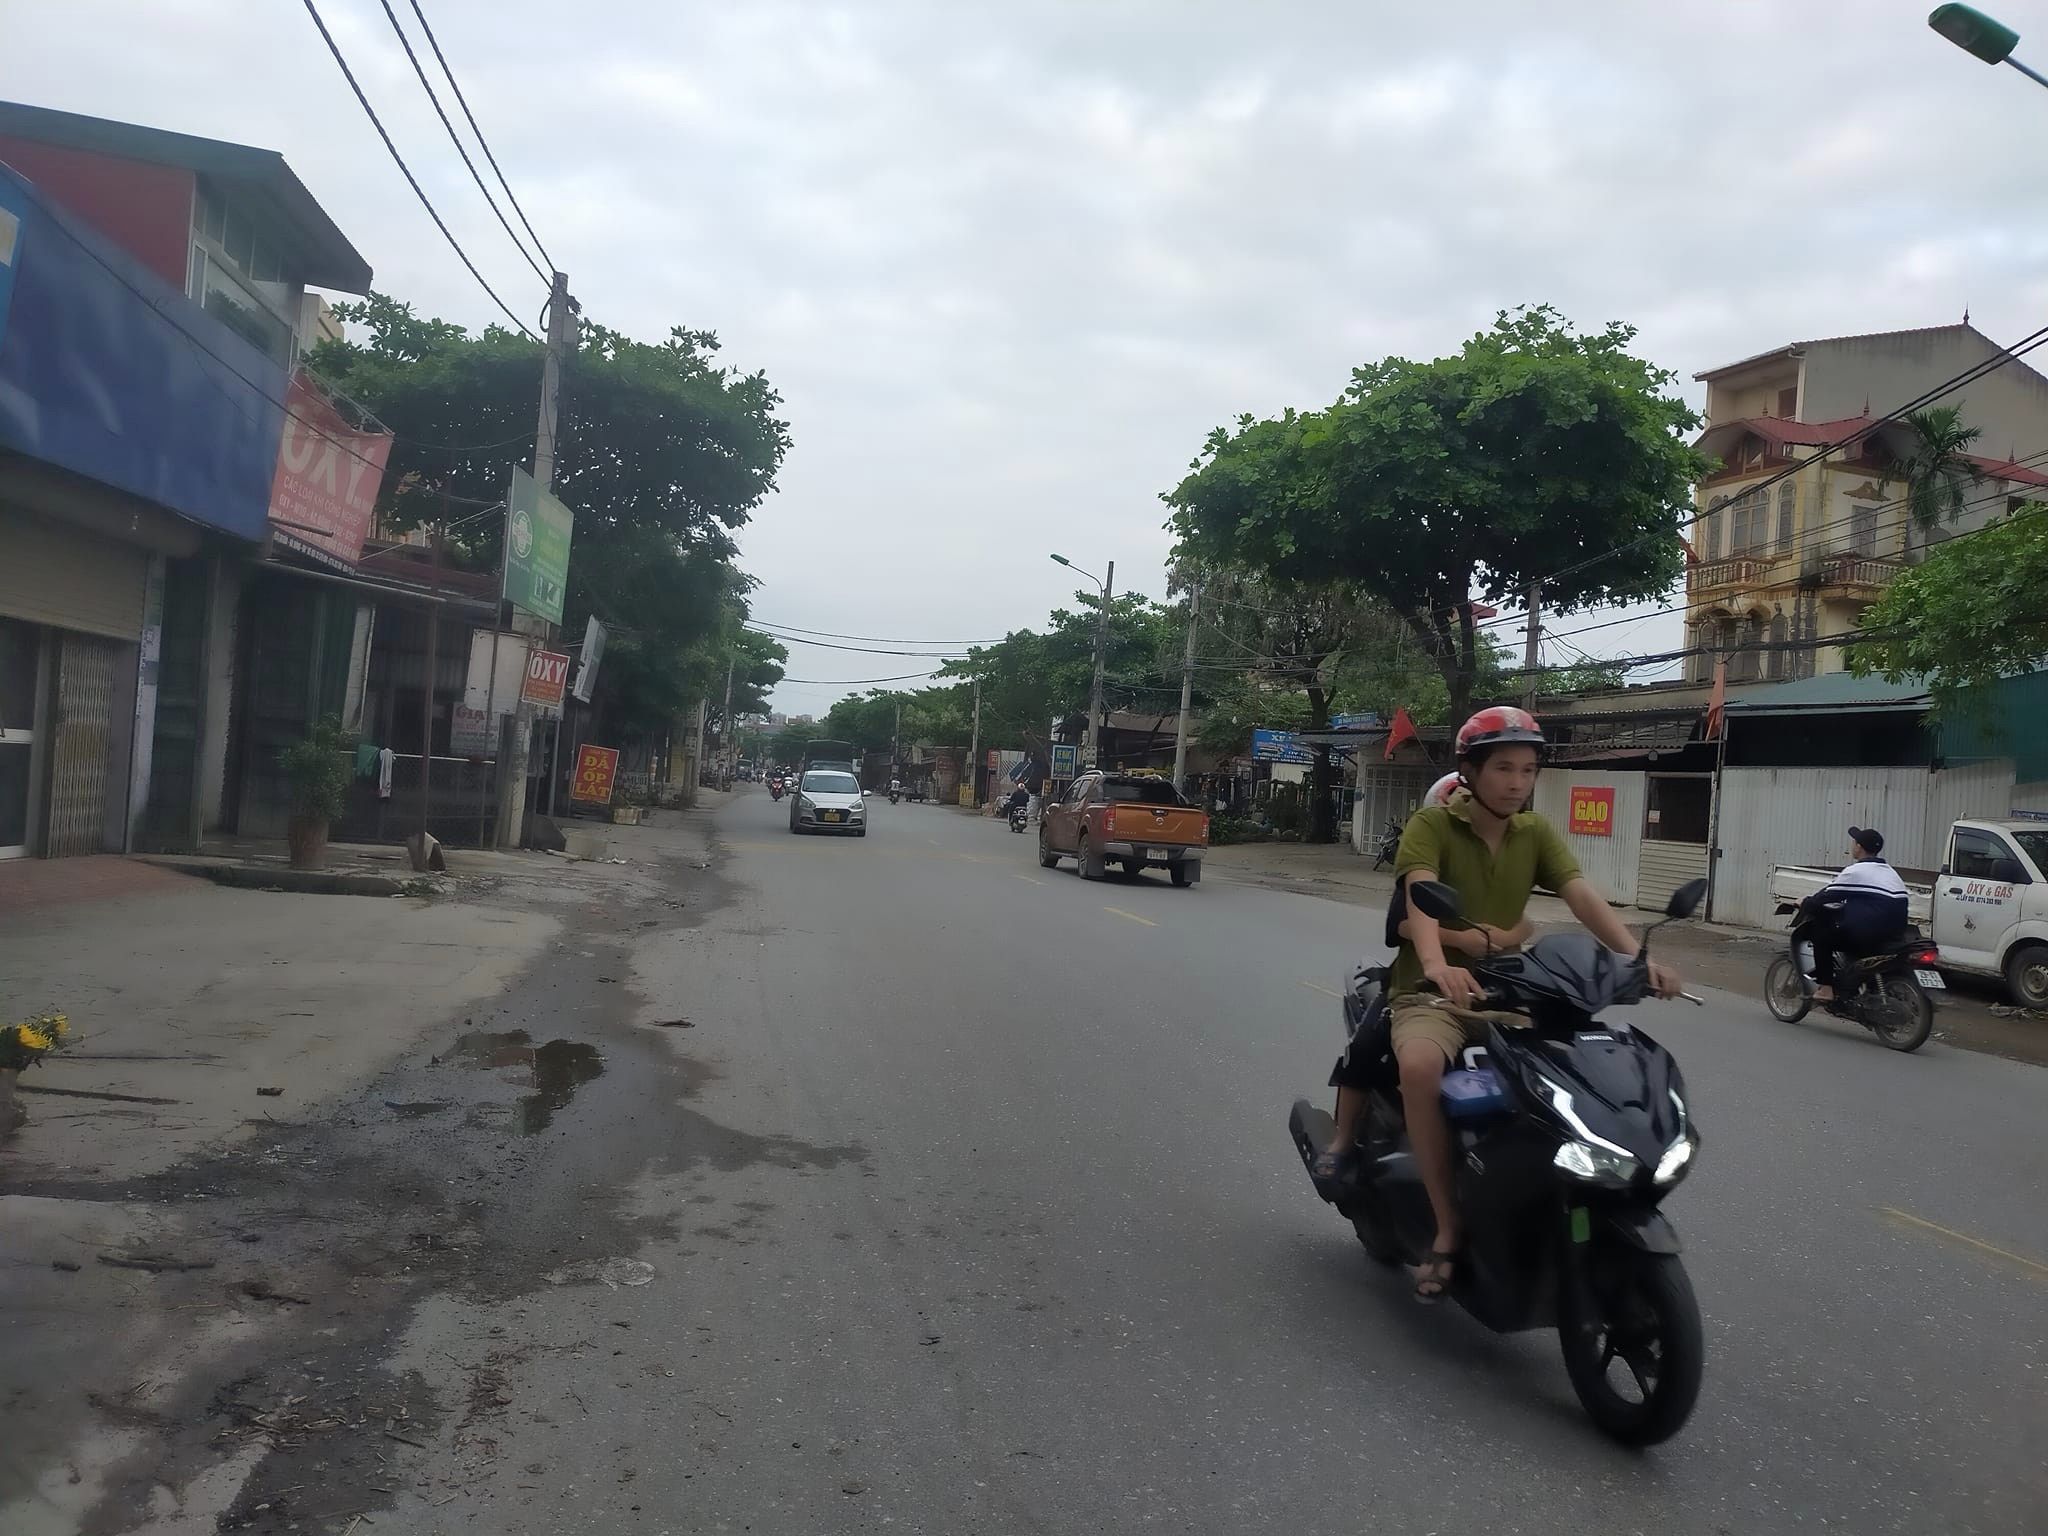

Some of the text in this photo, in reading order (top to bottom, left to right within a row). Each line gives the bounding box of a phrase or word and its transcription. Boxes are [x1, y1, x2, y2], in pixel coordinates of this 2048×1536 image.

[530, 652, 566, 684] ÔXY
[584, 755, 610, 770] ĐÁ
[583, 767, 607, 783] ỐP
[575, 781, 610, 797] LÁT
[1985, 886, 1993, 896] &
[1994, 886, 2014, 899] GAS
